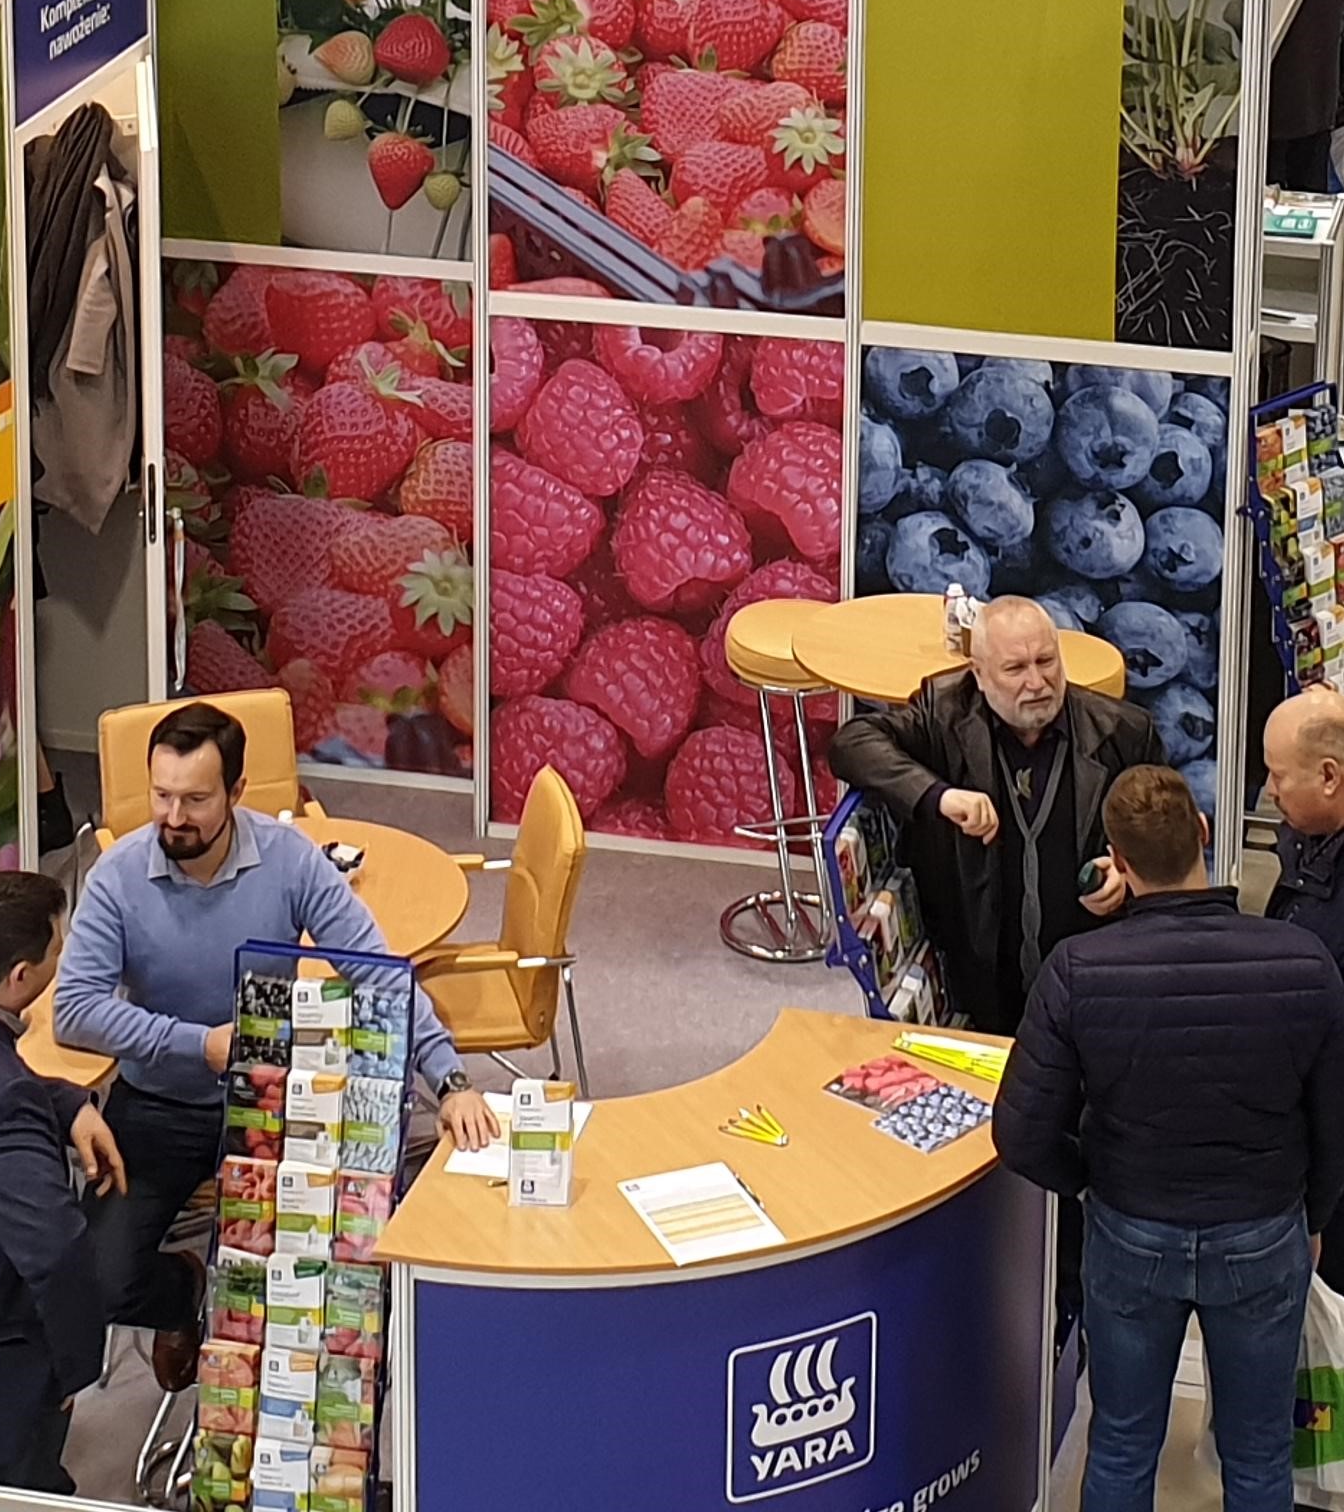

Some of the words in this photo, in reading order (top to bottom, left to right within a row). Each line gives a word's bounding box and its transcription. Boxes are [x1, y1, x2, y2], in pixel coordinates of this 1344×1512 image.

[49, 3, 111, 60] nawożenie:
[749, 1429, 856, 1481] YARA
[913, 1448, 982, 1511] grows
